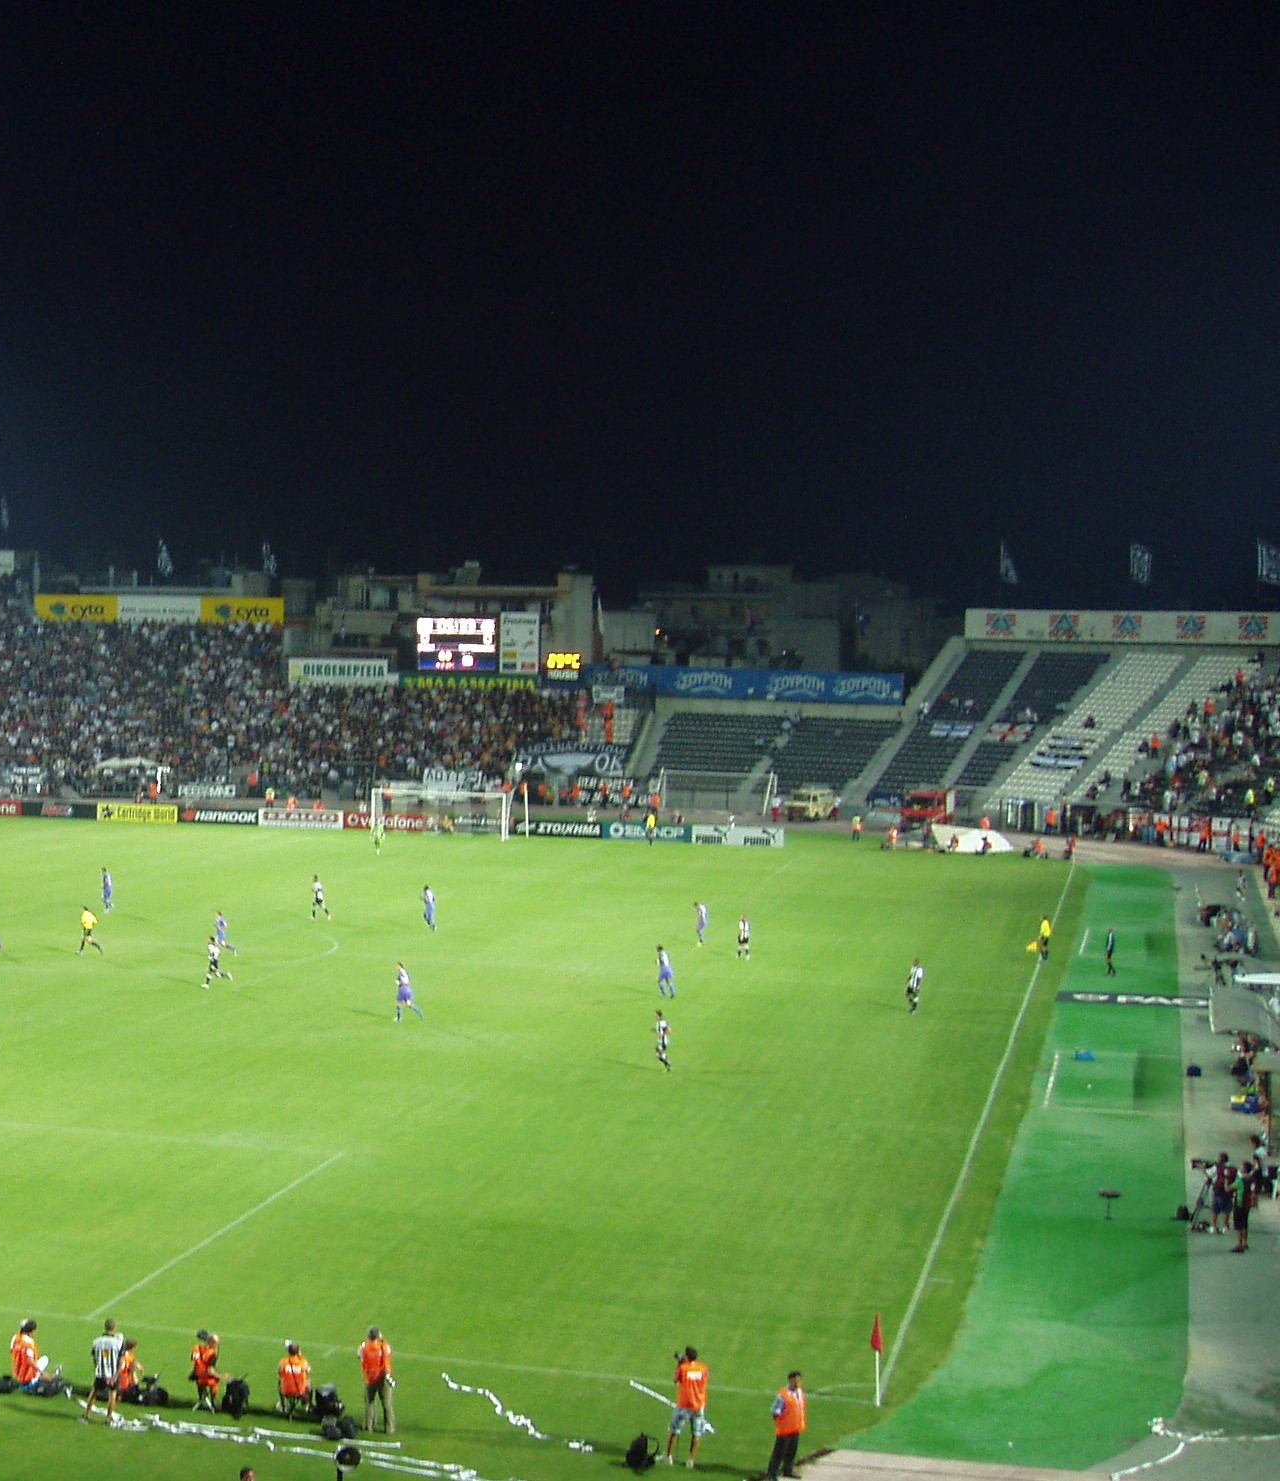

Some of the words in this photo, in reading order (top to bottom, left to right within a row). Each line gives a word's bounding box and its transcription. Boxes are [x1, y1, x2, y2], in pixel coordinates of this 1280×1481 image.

[71, 603, 105, 618] cyta
[236, 605, 270, 620] cyta
[695, 834, 723, 844] PUMA
[743, 836, 771, 846] PUMA
